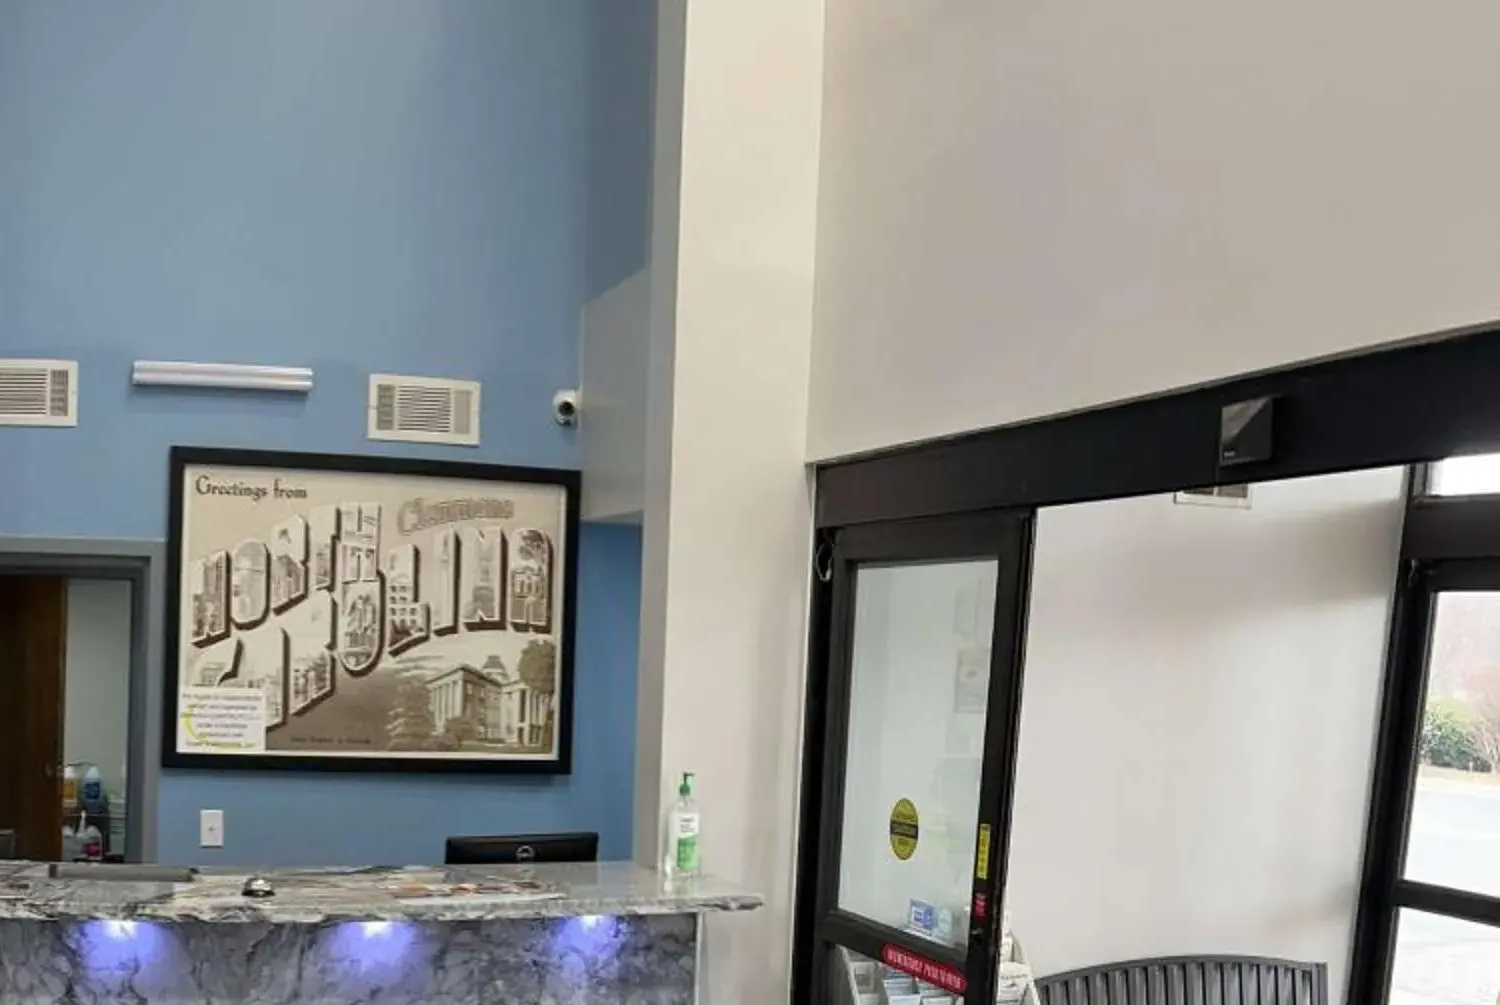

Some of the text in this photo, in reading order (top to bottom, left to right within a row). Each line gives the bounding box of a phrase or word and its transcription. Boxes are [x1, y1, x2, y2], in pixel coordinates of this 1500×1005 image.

[196, 475, 307, 502] Greetings from
[190, 503, 382, 648] NORTH
